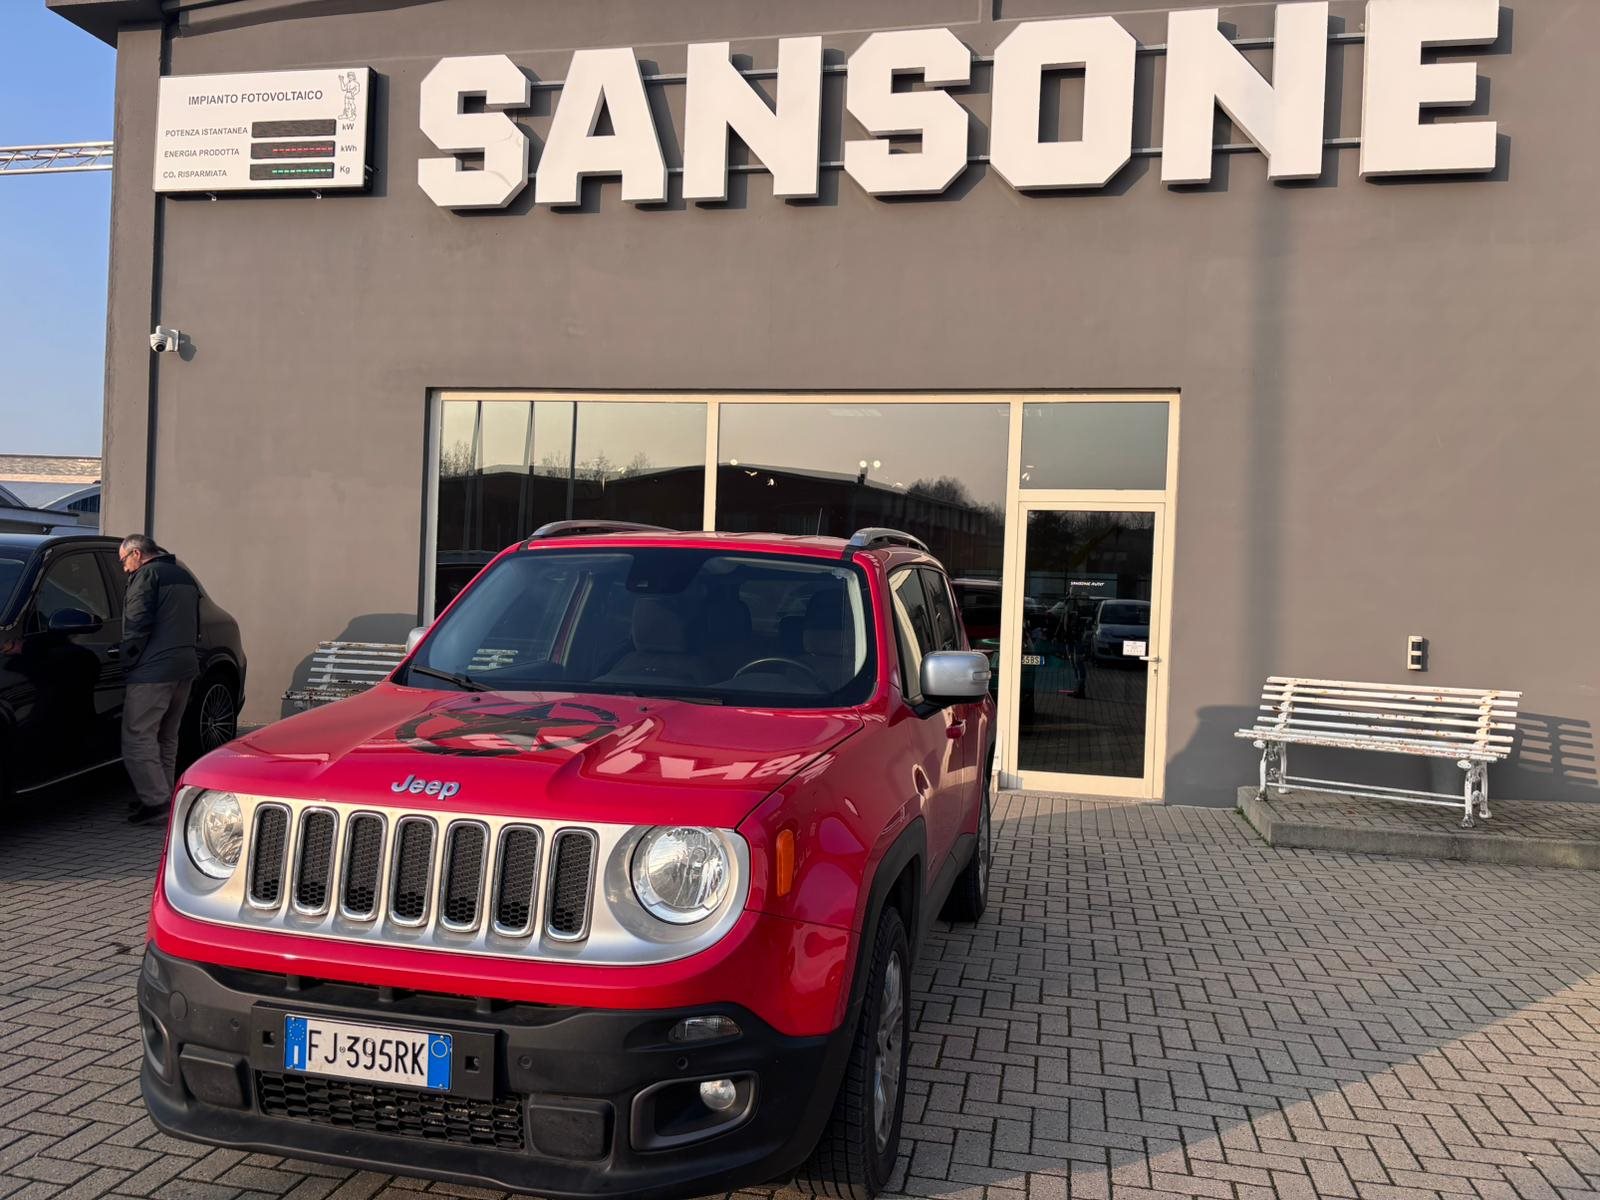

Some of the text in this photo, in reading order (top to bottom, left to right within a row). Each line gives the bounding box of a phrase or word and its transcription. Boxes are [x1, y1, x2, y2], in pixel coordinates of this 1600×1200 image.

[188, 90, 323, 106] IMPIANTO FOTOVOLTAICO
[418, 0, 1500, 208] SANSONE
[165, 127, 248, 137] POTENZA ISTANTANEA
[164, 148, 240, 158] ENERGIA PRODOTTA
[341, 144, 358, 152] kWh
[177, 170, 227, 178] RISPARMIATA
[340, 166, 351, 175] Kg
[391, 774, 461, 800] Jeep
